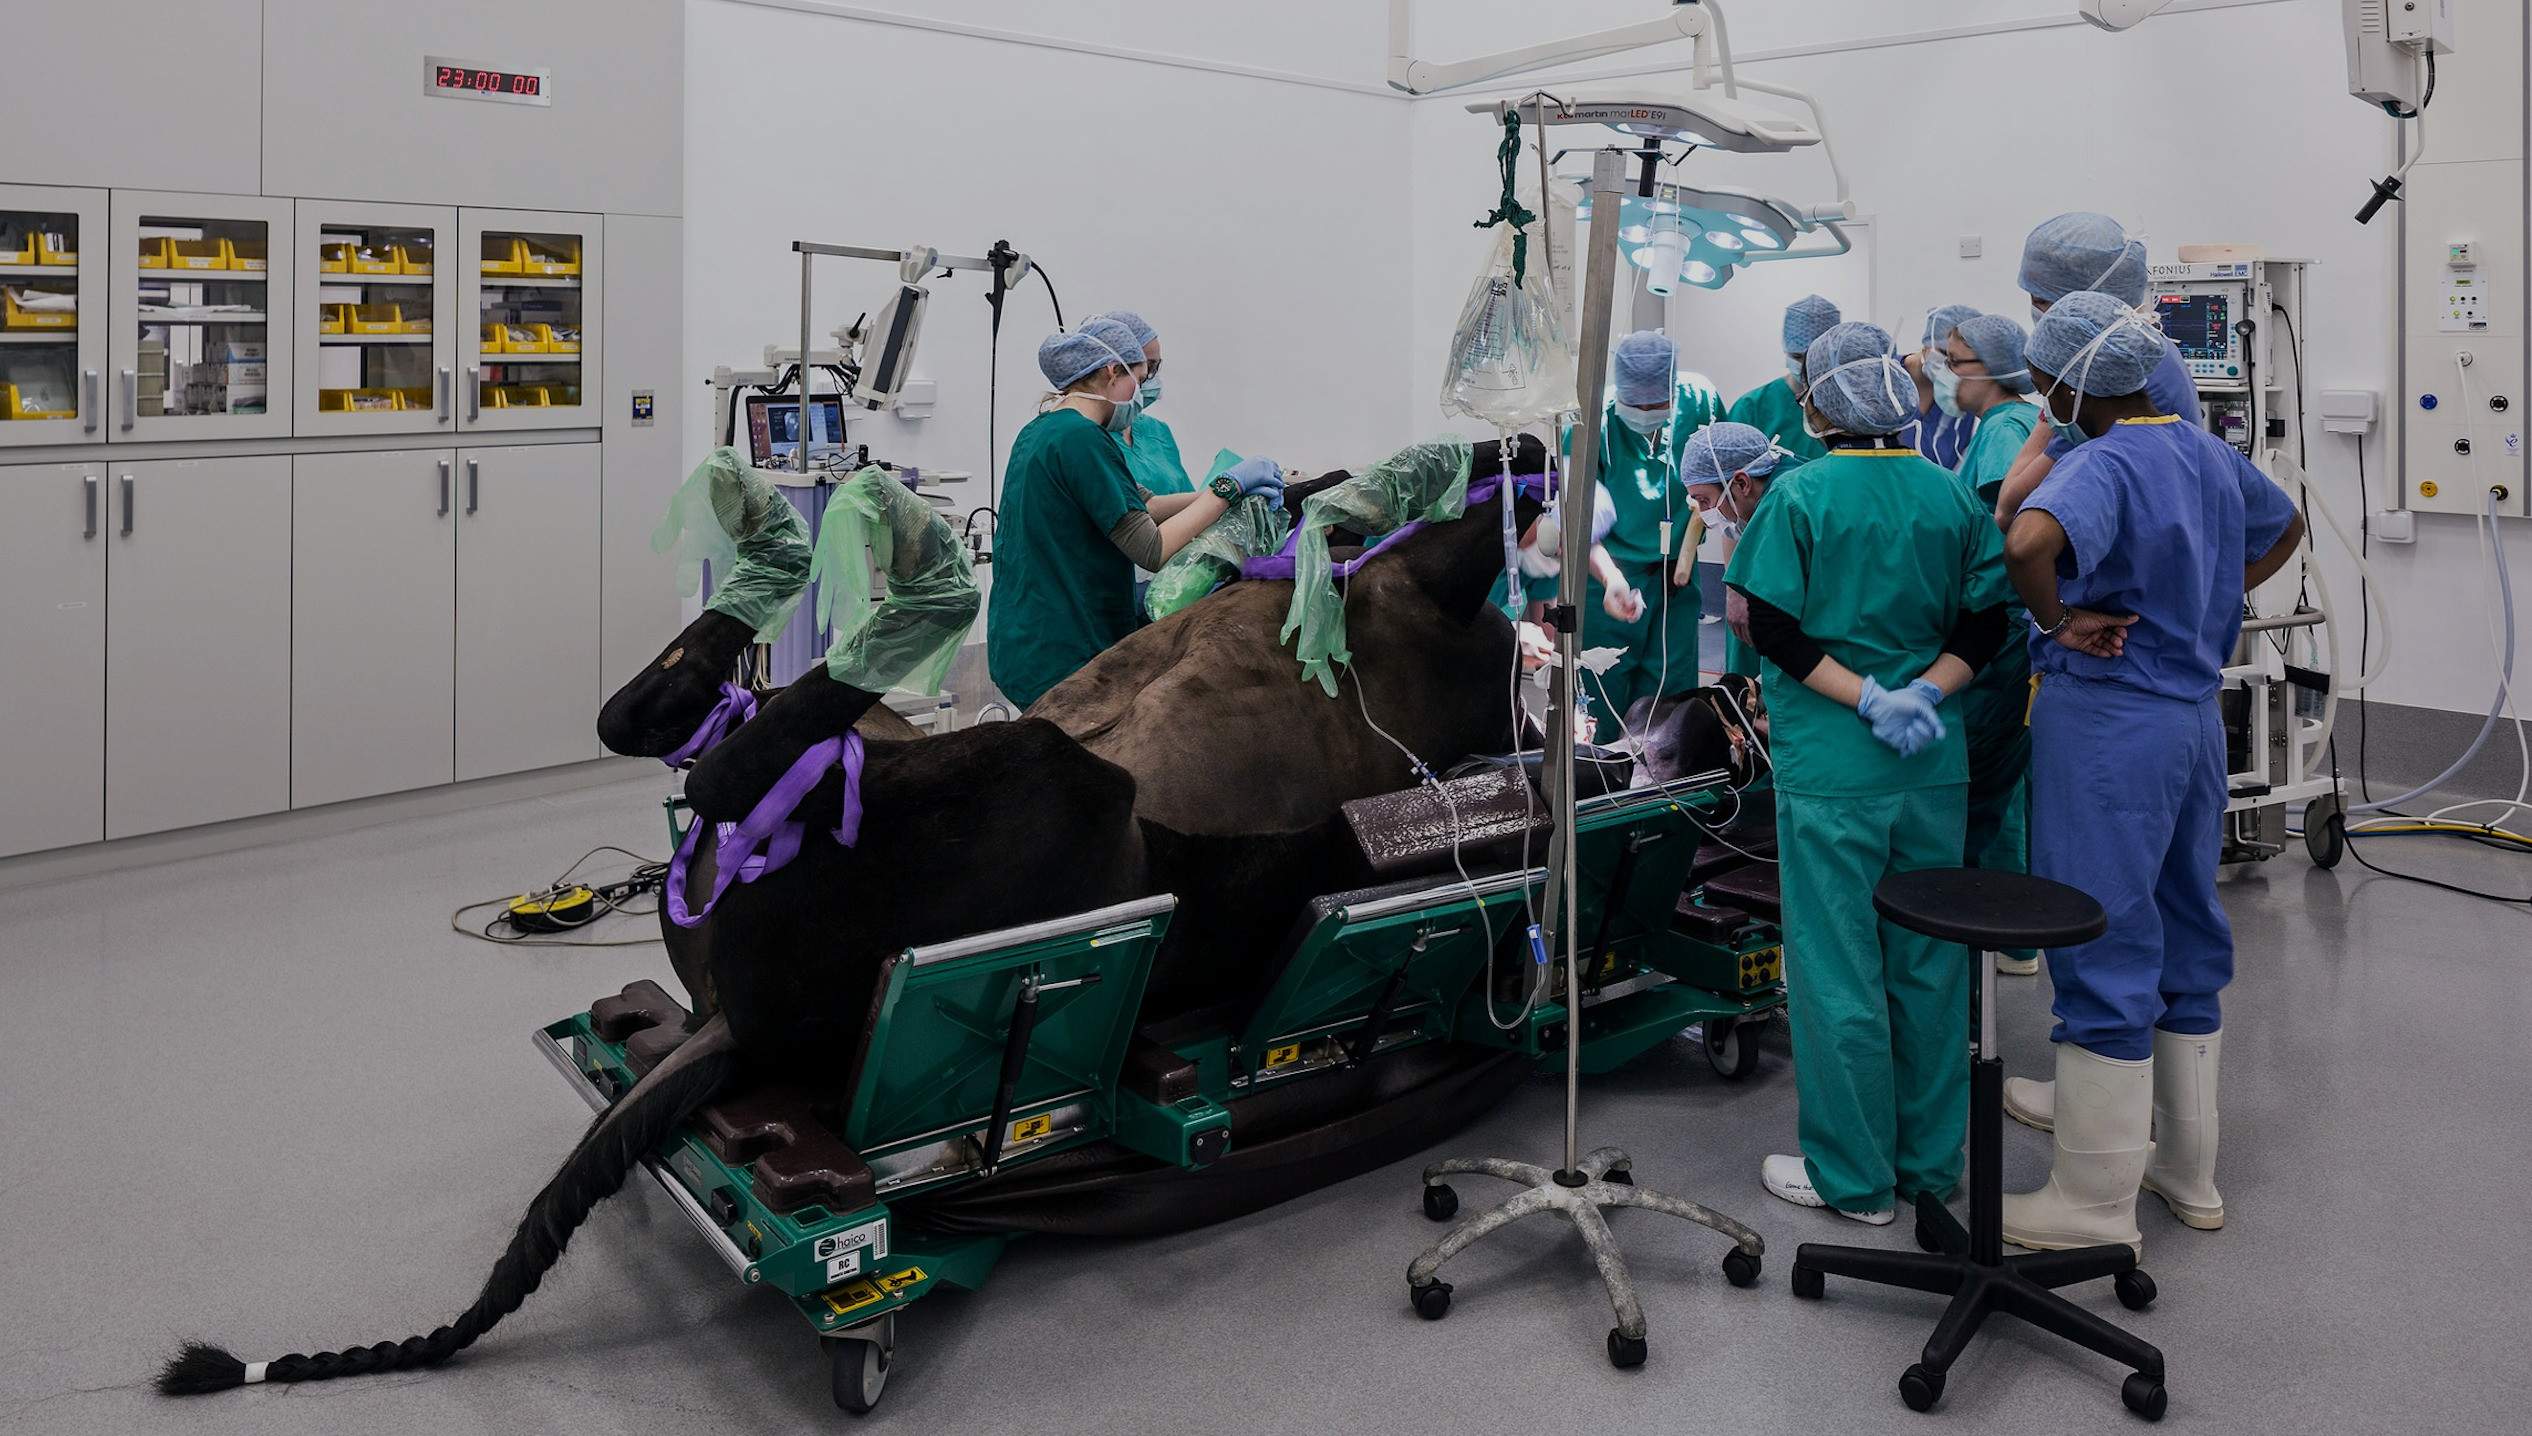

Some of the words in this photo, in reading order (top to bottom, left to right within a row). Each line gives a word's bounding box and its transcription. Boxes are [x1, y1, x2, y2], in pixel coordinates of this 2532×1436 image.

[438, 68, 501, 92] 23:00
[512, 76, 538, 95] 00
[1574, 110, 1608, 119] martin
[2147, 264, 2191, 276] FONIUS
[837, 1233, 866, 1250] haico
[838, 1258, 850, 1271] RC
